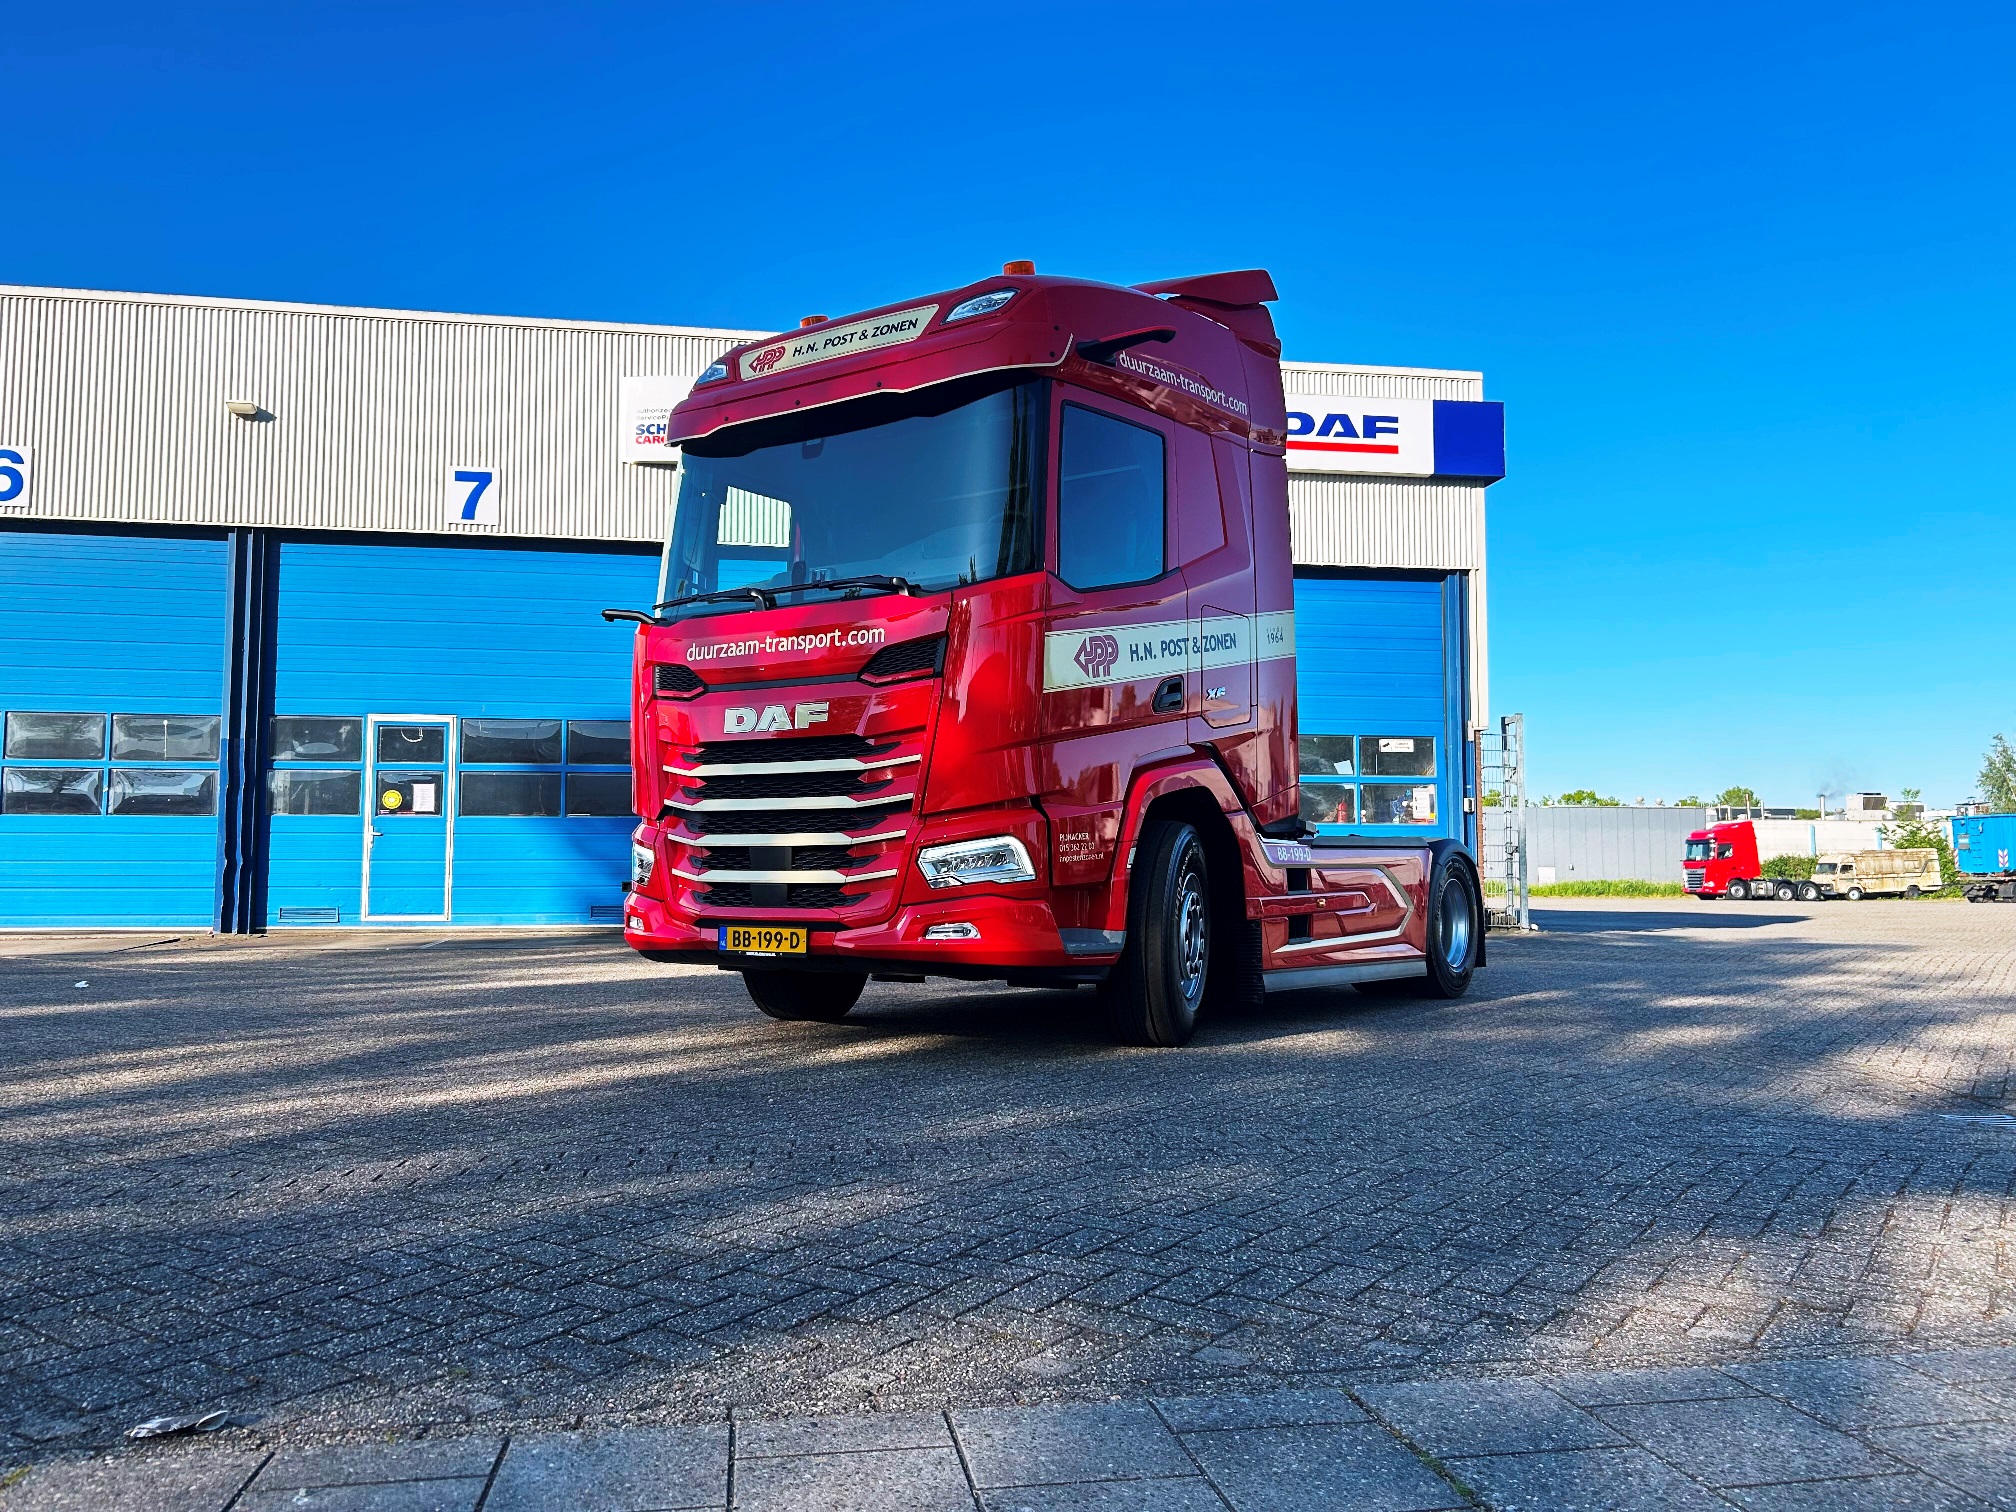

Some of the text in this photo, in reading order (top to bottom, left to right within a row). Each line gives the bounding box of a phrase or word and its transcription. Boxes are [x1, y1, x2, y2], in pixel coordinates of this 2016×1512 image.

[793, 342, 818, 357] H.N.
[823, 331, 857, 350] POST
[859, 329, 868, 341] &
[871, 318, 919, 338] ZONEN
[1119, 350, 1248, 416] duurzaam-transport.com
[1286, 412, 1399, 439] DAF
[0, 449, 25, 501] 6
[455, 471, 493, 520] 7
[686, 627, 885, 661] duurzaam-transport.com
[1129, 642, 1157, 662] H.N.
[1161, 638, 1189, 657] POST
[1192, 636, 1201, 654] &
[1203, 633, 1237, 653] ZONEN
[1267, 632, 1284, 644] 1964
[724, 702, 830, 734] DAF
[1277, 847, 1311, 861] BB-199-D
[732, 930, 800, 949] BB-199-D
